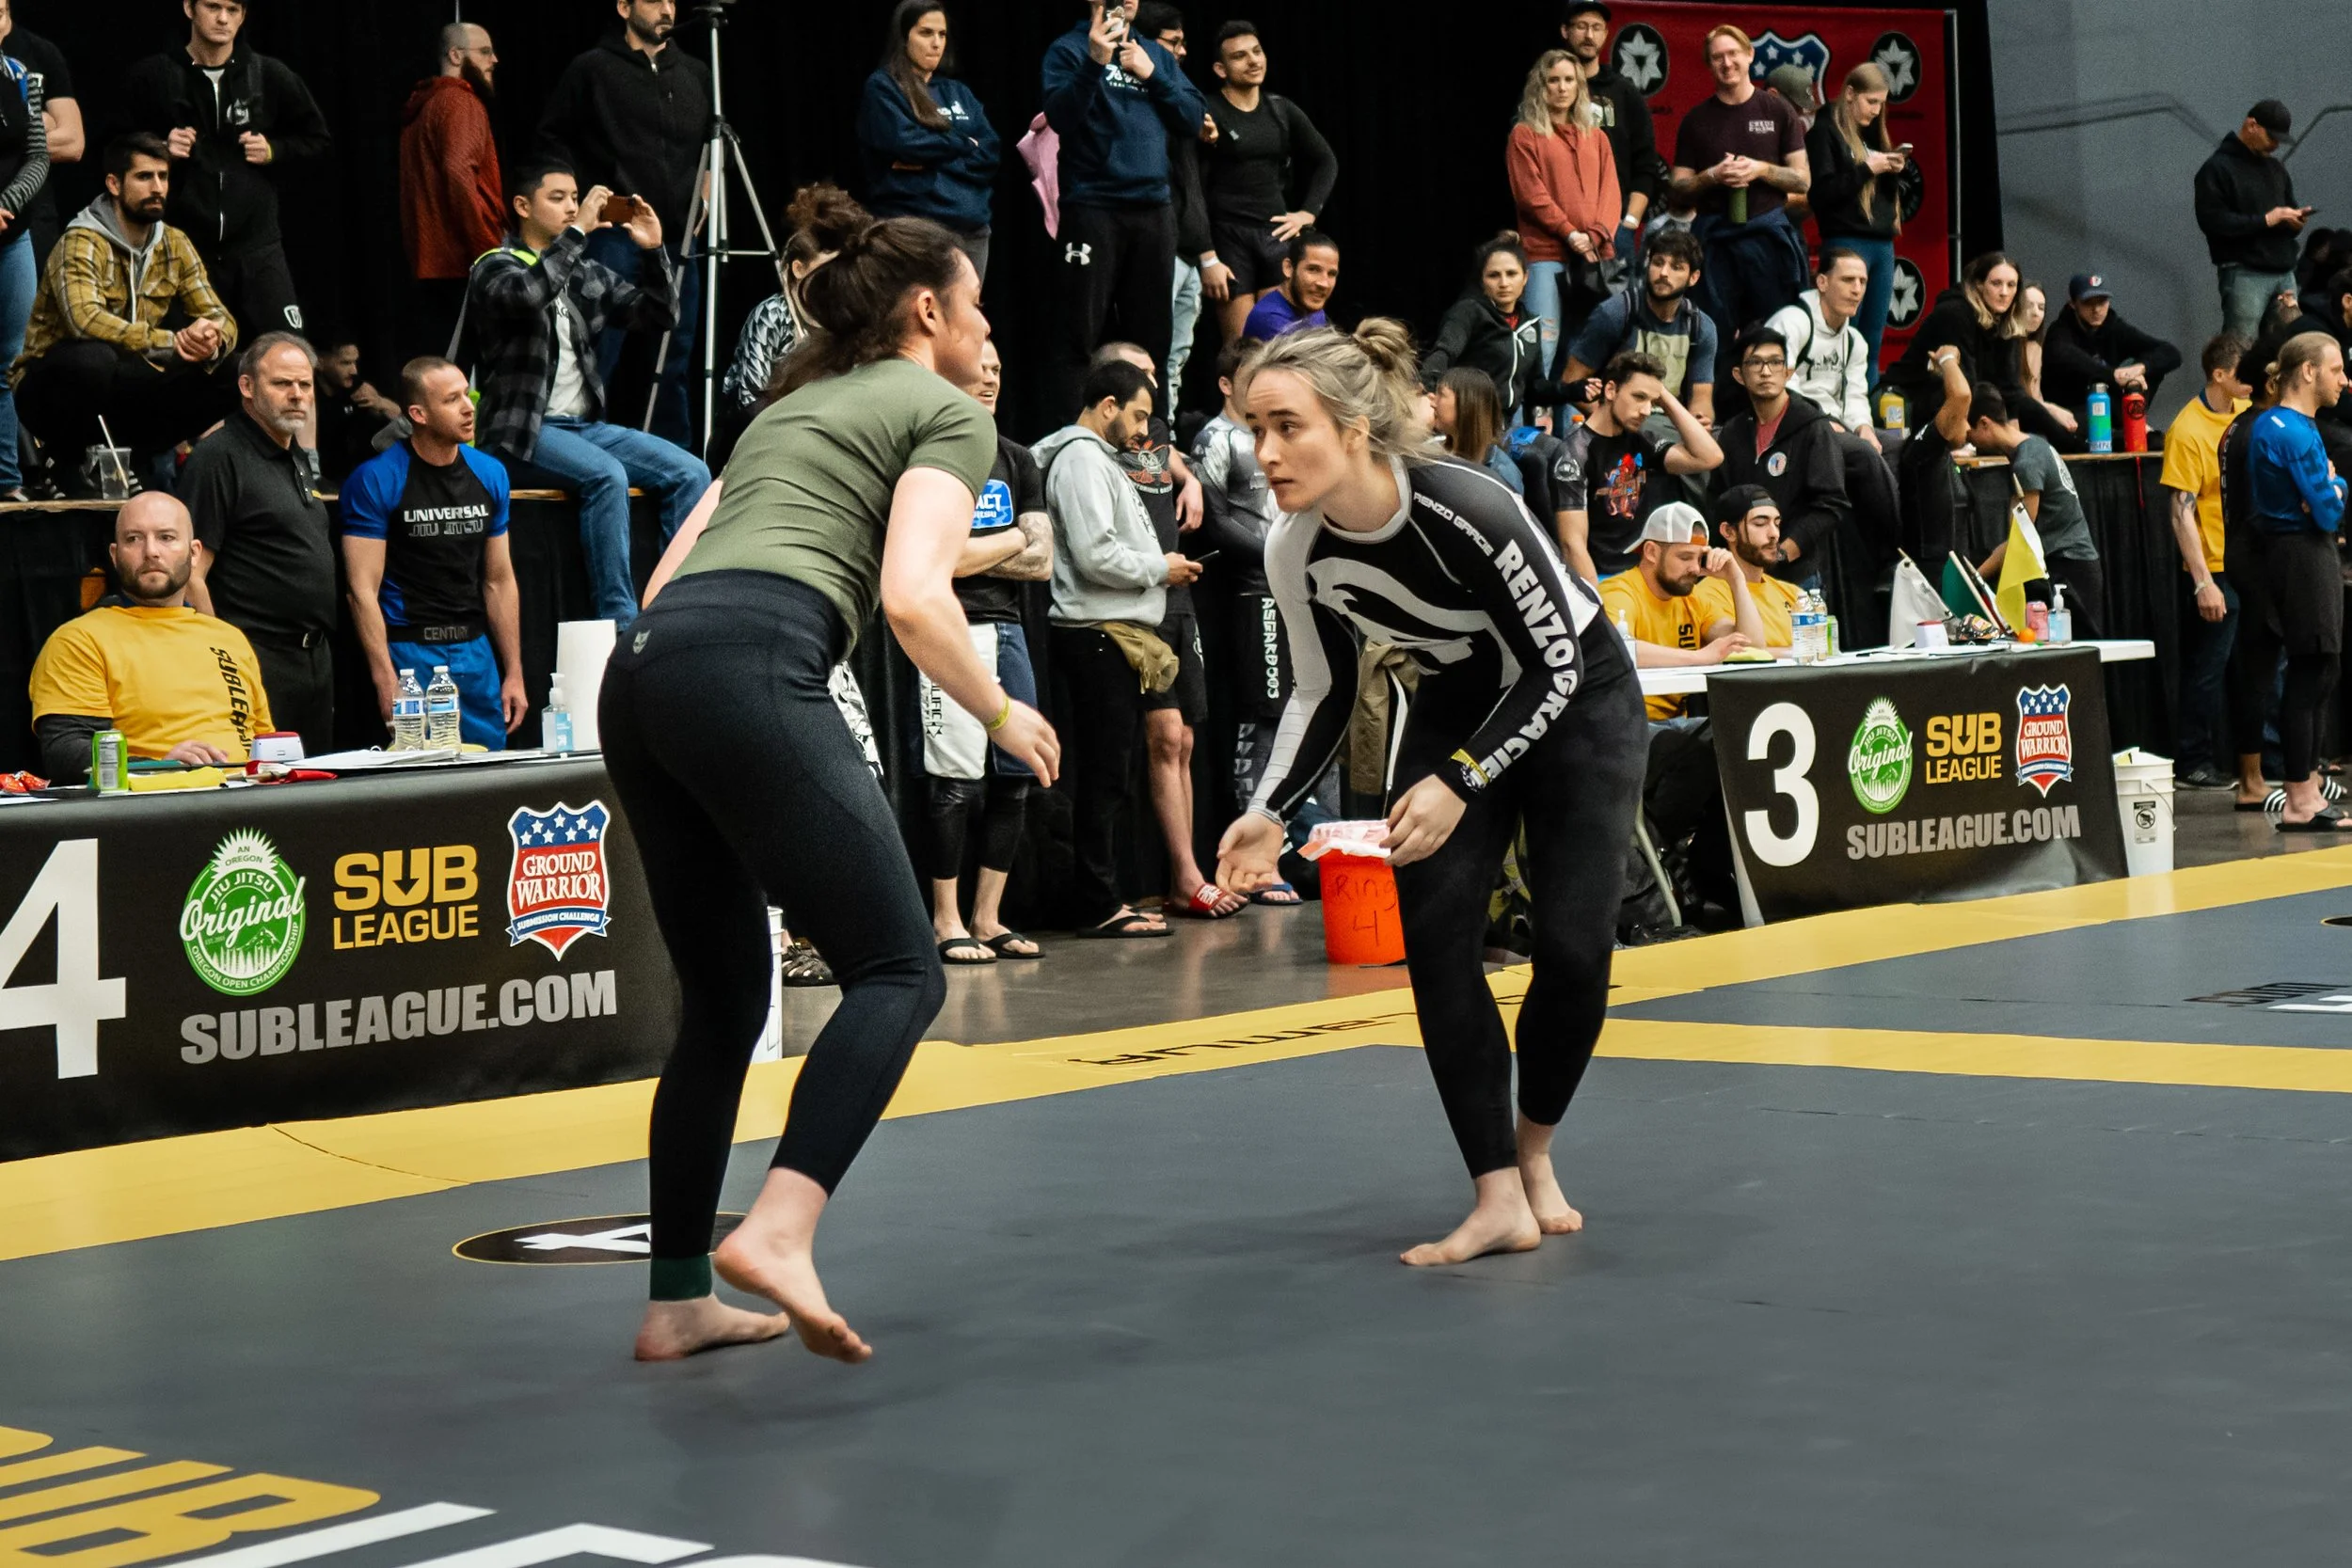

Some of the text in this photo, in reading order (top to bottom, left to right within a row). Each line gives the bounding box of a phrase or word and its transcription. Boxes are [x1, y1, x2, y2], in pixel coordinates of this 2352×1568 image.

[404, 504, 489, 523] UNIVERSAL
[976, 494, 1002, 512] ACT
[1413, 492, 1454, 521] RENZO
[408, 518, 485, 537] JIU JITSU
[1926, 712, 2002, 757] SUB
[2024, 720, 2064, 737] GROUND
[1848, 731, 1914, 781] Original
[2020, 735, 2069, 760] WARRIOR
[1745, 702, 1820, 867] 3
[1926, 754, 2002, 784] LEAGUE
[1847, 804, 2082, 861] SUBLEAGUE.COM
[225, 854, 263, 866] OREGON
[333, 845, 478, 911] SUB
[522, 851, 596, 877] GROUND
[210, 872, 275, 905] JIU JITSU
[516, 872, 603, 911] WARRIOR
[1336, 875, 1397, 911] Ring
[180, 876, 307, 949] Original
[333, 904, 479, 950] LEAGUE
[516, 912, 600, 930] SUBMISSION CHALLENGE
[1353, 911, 1379, 947] 4
[0, 838, 126, 1079] 4
[191, 921, 299, 989] OREGON OPEN CHAMPIONSHIP
[181, 970, 617, 1065] SUBLEAGUE.COM
